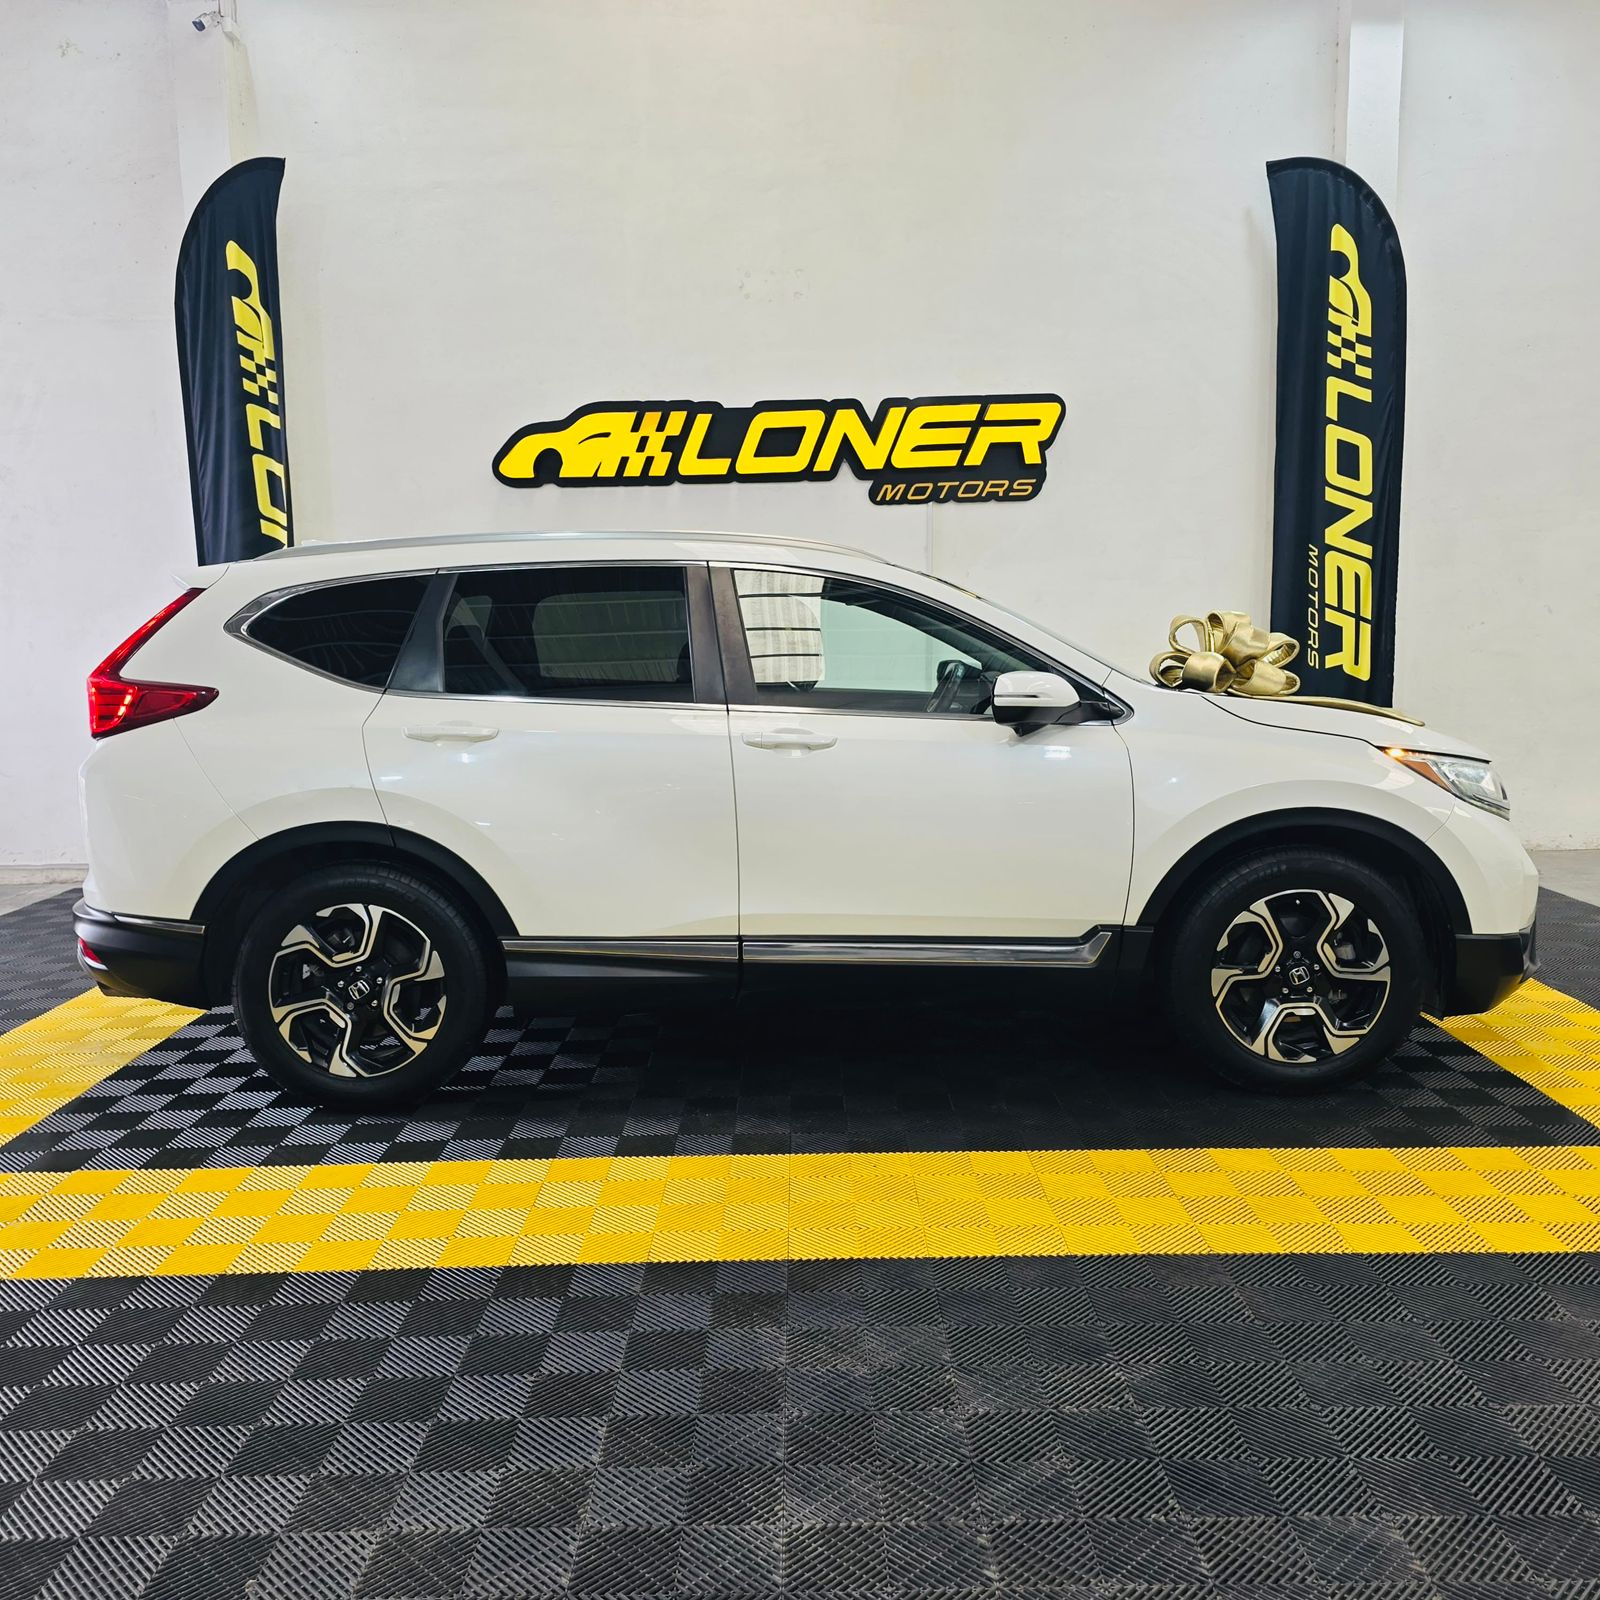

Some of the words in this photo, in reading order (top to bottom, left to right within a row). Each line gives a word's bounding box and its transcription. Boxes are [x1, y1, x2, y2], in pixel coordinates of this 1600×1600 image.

[678, 402, 1061, 476] LONER
[876, 478, 1037, 501] MOTORS
[1325, 376, 1373, 682] LONER
[1308, 543, 1319, 670] MOTORS
